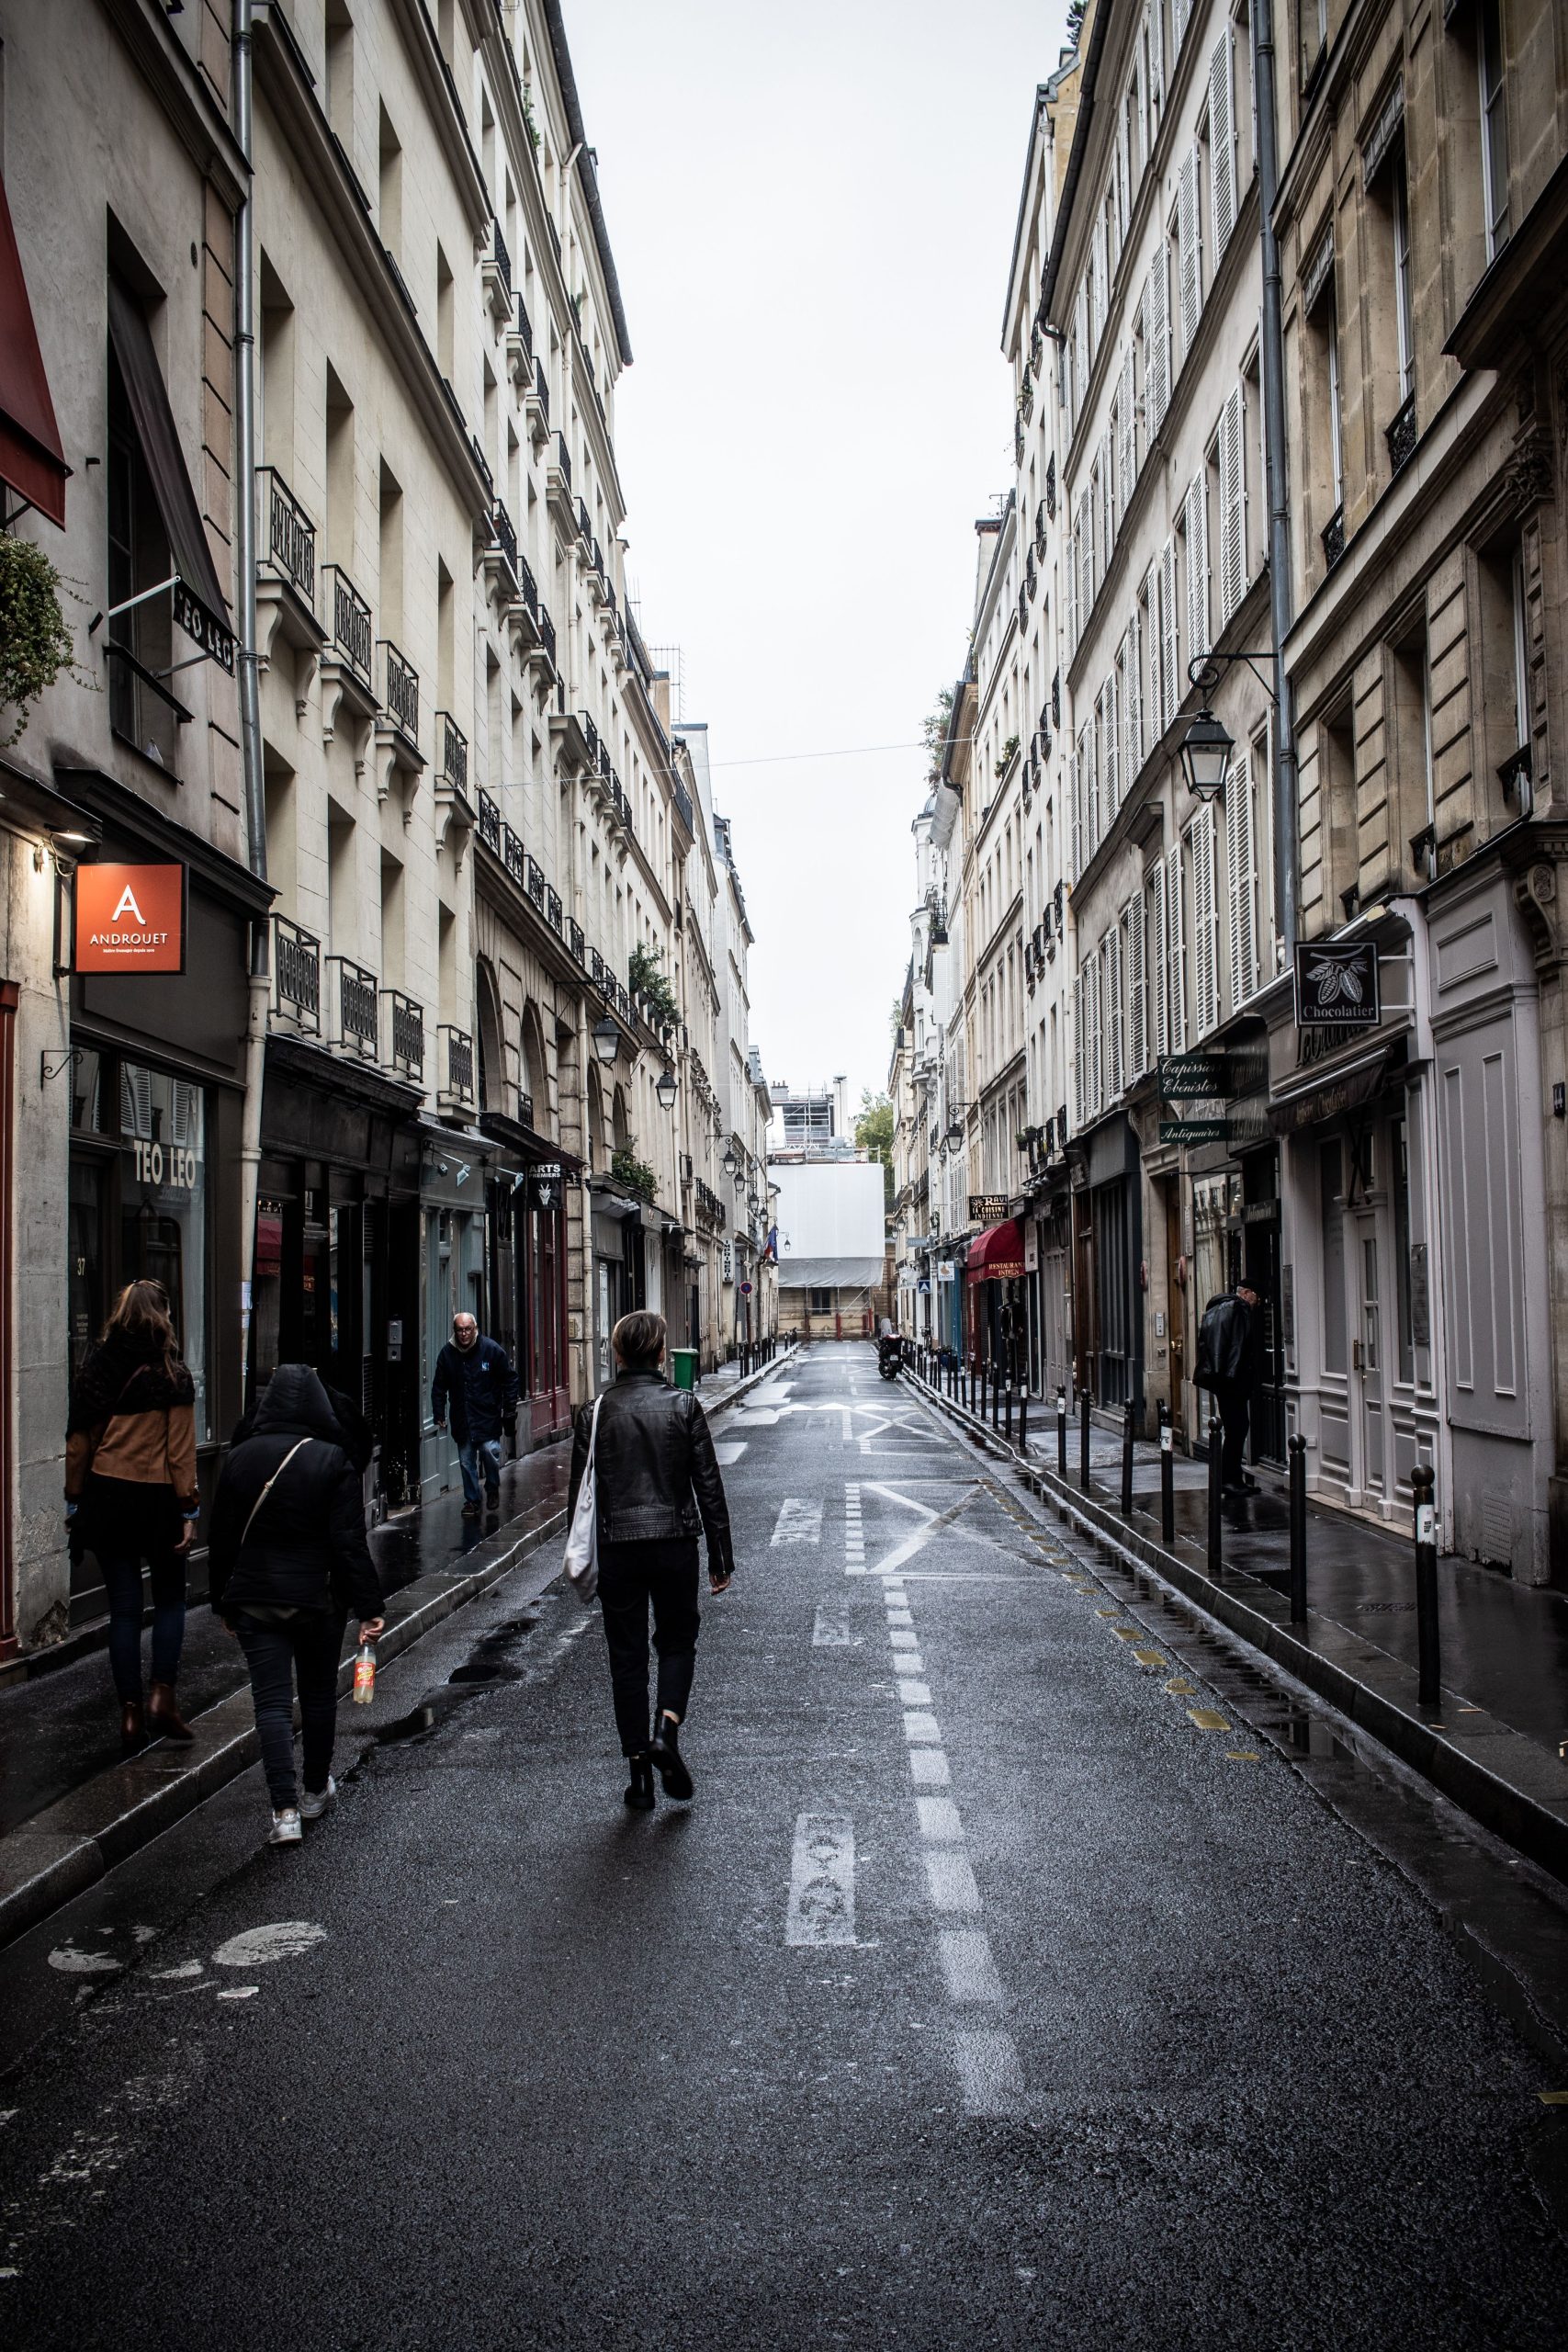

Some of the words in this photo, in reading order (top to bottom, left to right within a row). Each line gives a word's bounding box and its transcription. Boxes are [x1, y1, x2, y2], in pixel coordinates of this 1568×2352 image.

[208, 622, 231, 665] LEO
[111, 884, 147, 925] A
[90, 933, 168, 945] ANDROUET
[1303, 1004, 1374, 1018] Chocolatier
[1160, 1127, 1220, 1141] Antiquaires
[133, 1139, 163, 1185] TEO
[170, 1147, 196, 1189] LEO
[529, 1164, 560, 1173] ARTS
[77, 1257, 85, 1275] 37
